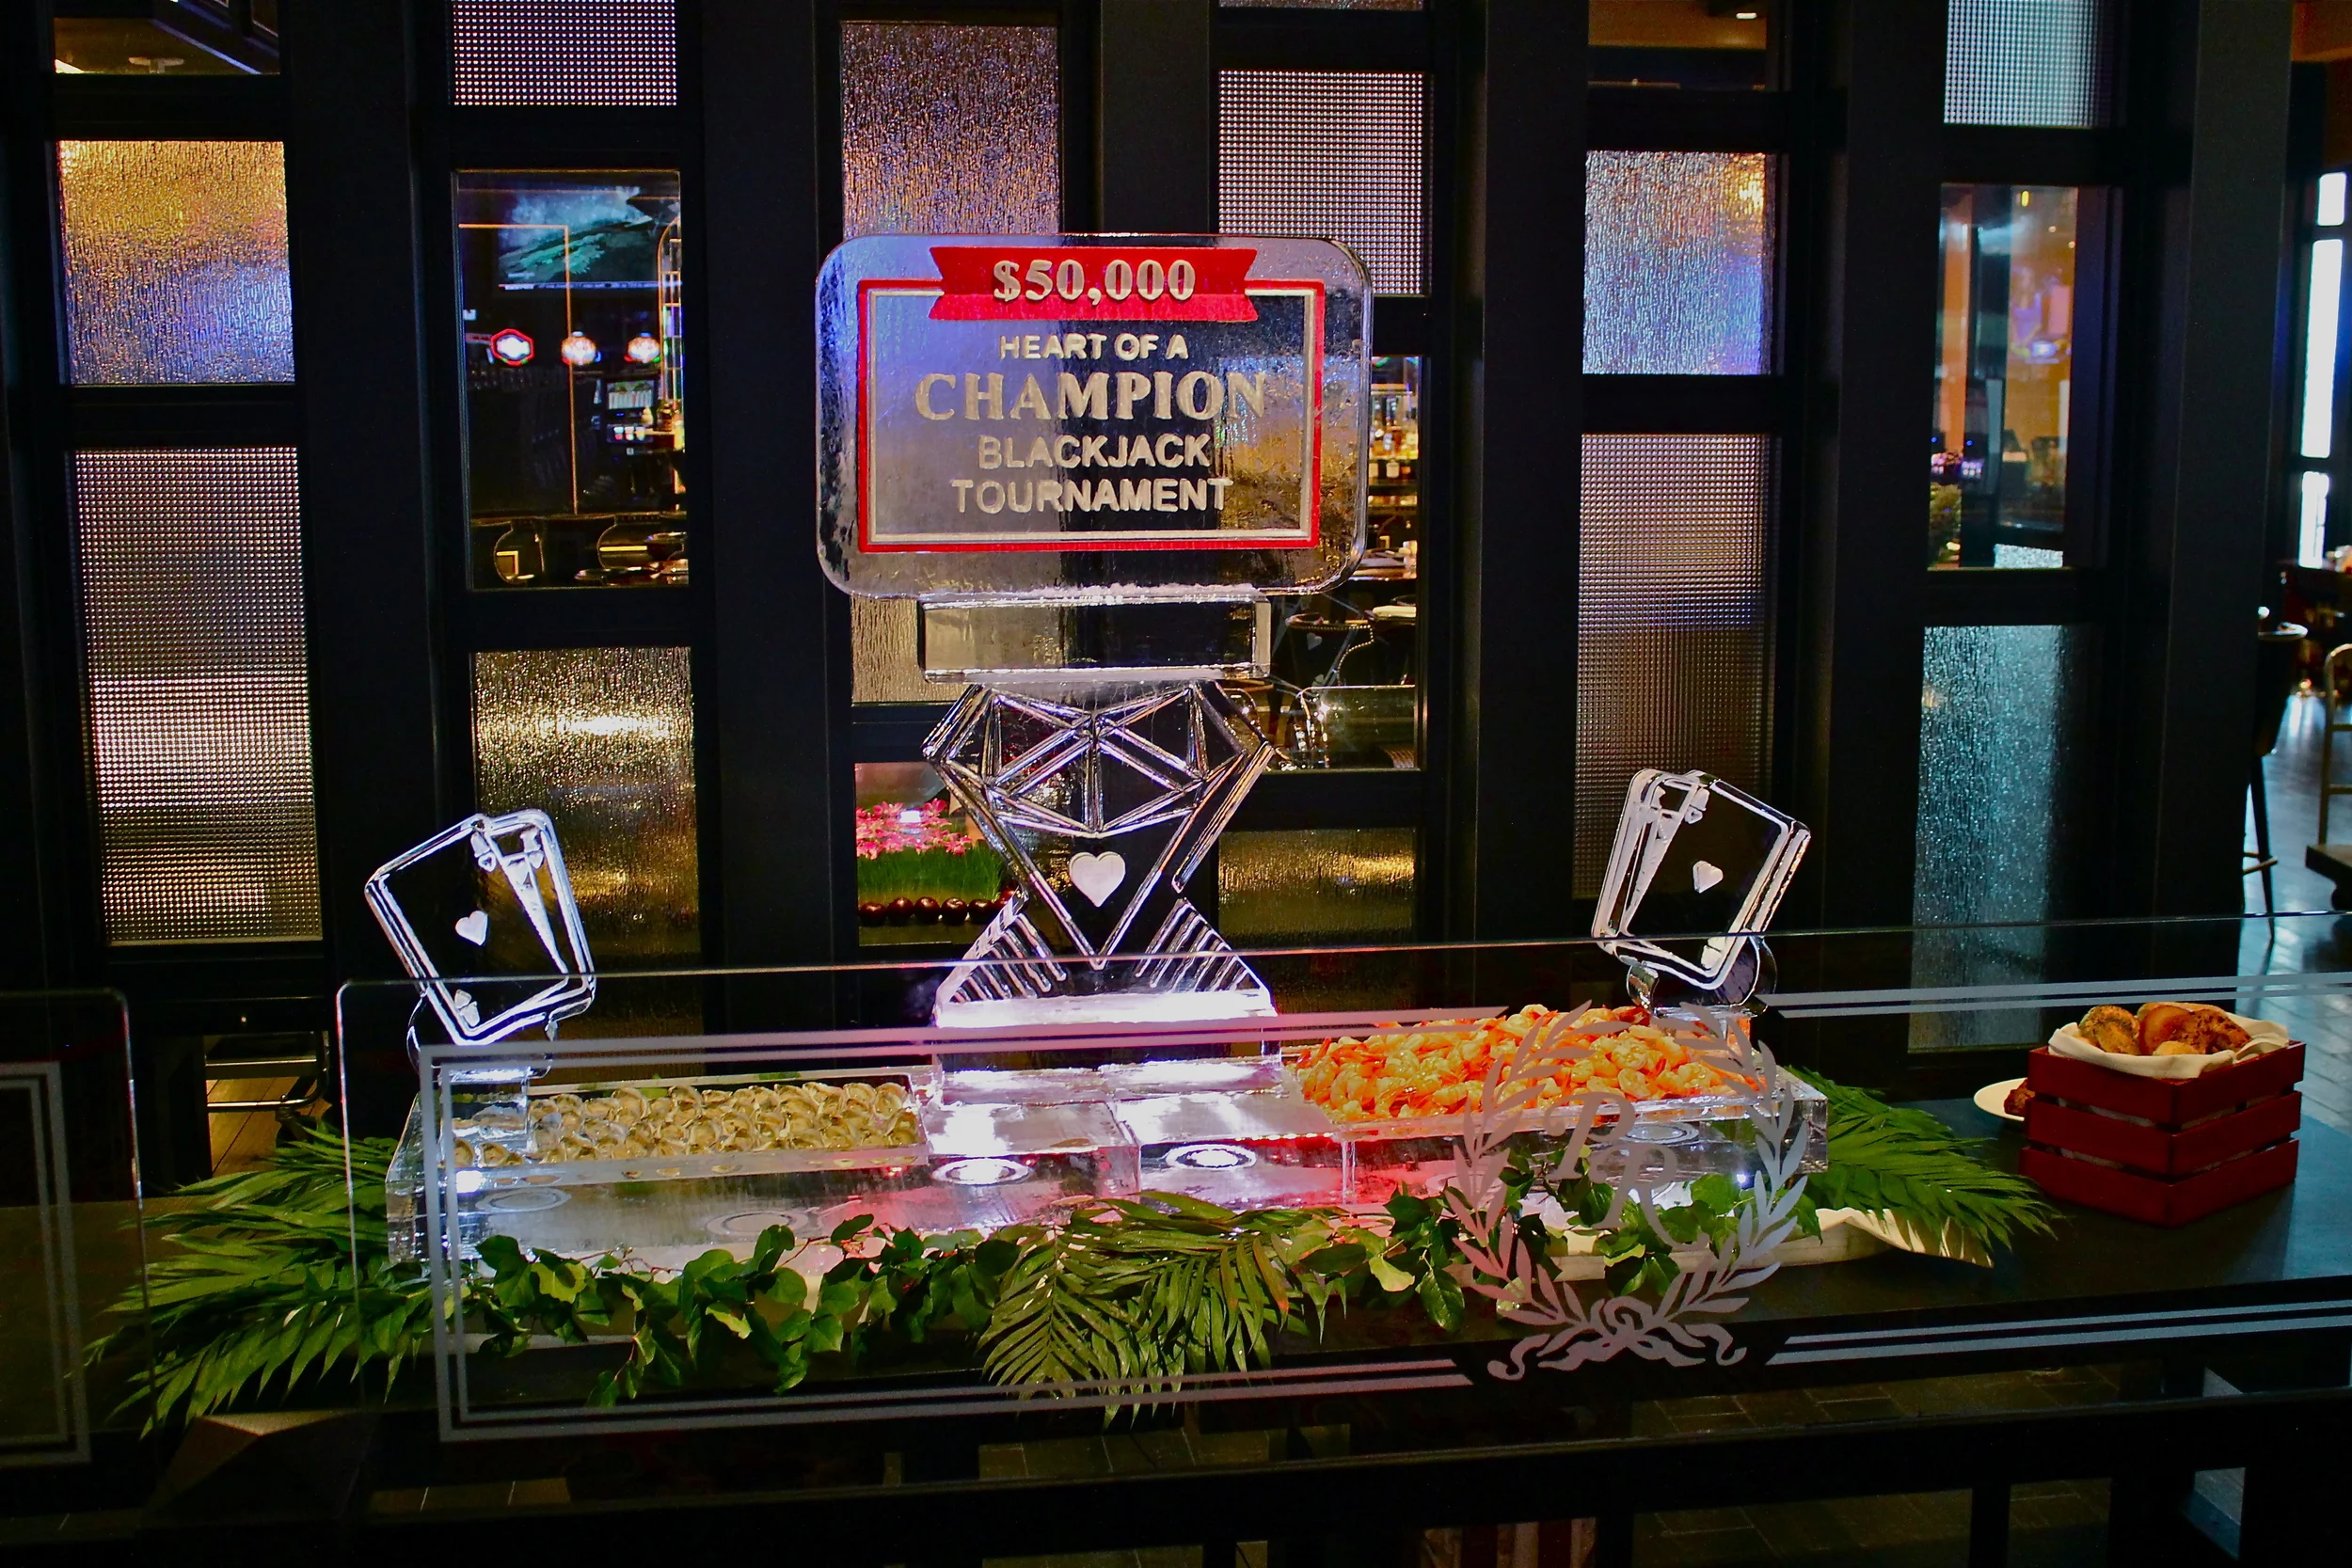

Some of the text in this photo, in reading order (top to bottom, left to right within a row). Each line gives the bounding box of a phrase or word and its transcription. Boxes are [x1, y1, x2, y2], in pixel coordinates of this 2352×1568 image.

[993, 260, 1196, 305] $50,000
[999, 334, 1189, 359] HEART OF A
[914, 372, 1266, 420] CHAMPION
[978, 436, 1211, 469] BLACKJACK
[951, 478, 1234, 514] TOURNAMENT
